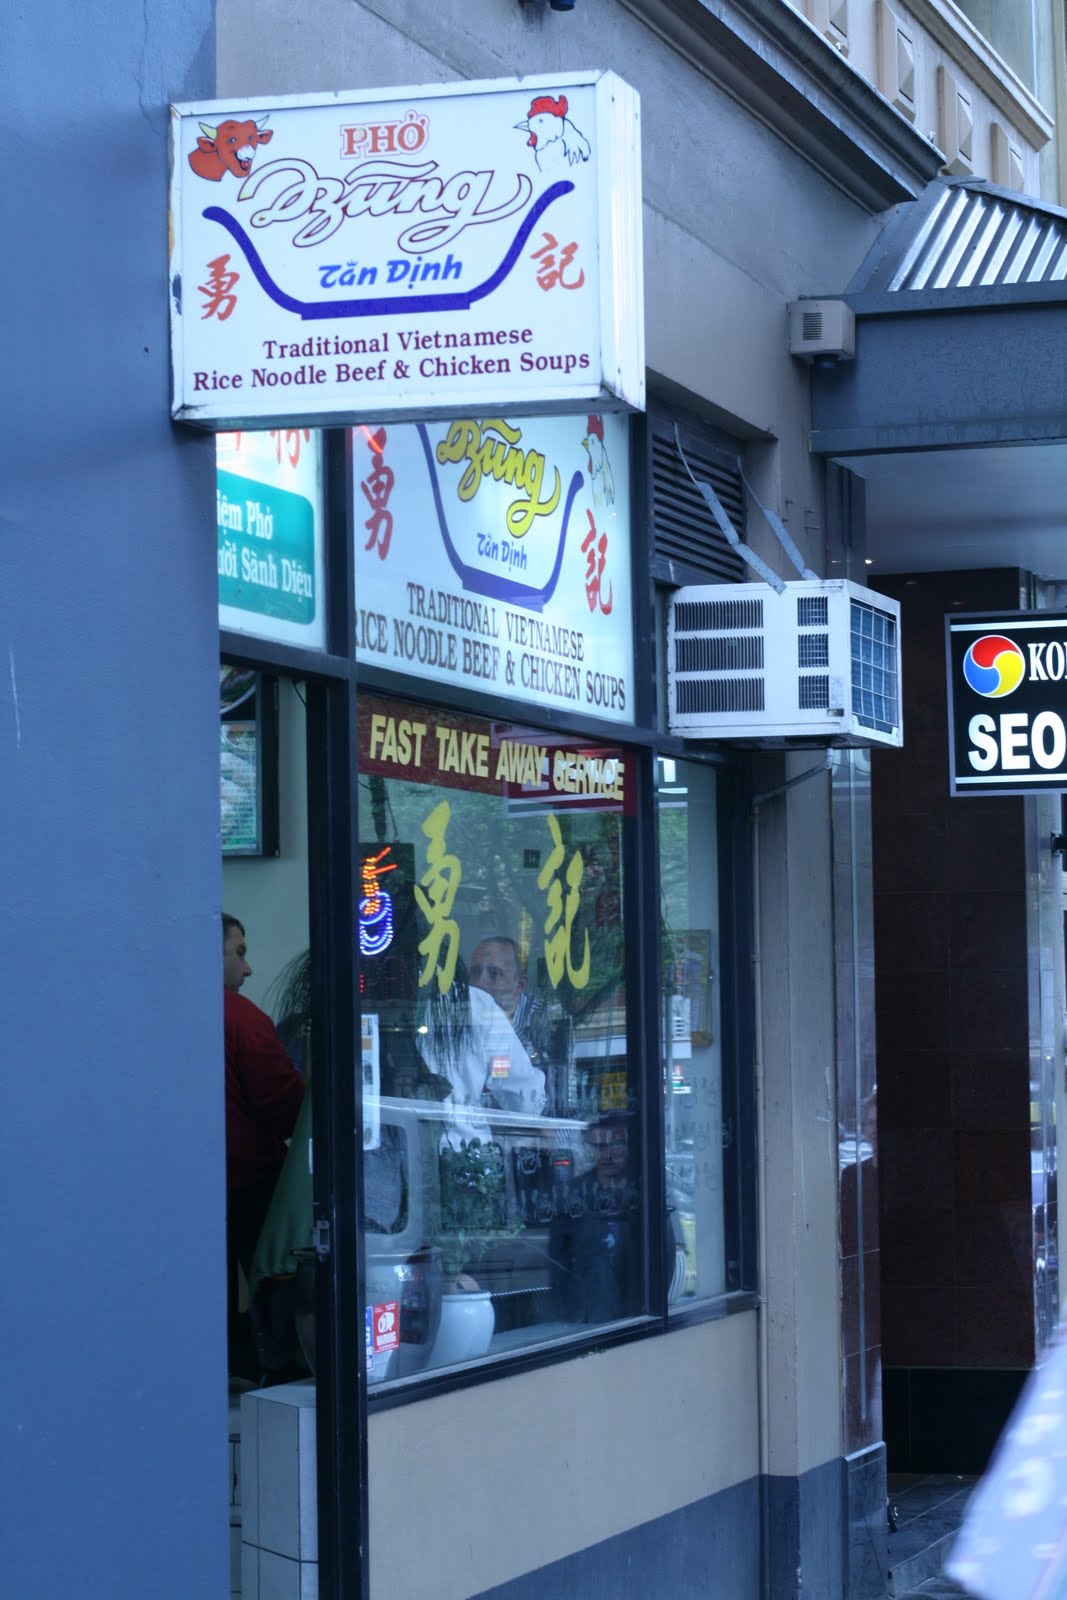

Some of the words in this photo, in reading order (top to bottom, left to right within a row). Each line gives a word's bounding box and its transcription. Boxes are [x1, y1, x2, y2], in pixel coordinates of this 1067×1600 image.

[340, 110, 429, 158] PHỞ
[198, 254, 240, 321] 勇
[530, 232, 585, 292] 記
[194, 371, 243, 391] Rice
[251, 364, 326, 387] Noodle
[335, 363, 386, 383] Beef
[393, 360, 410, 378] &
[419, 353, 511, 377] Chicken
[519, 352, 590, 375] Soups
[263, 333, 389, 360] Traditional
[398, 327, 533, 352] Vietnamese
[407, 582, 499, 639] TRADITIONAL
[505, 611, 584, 662] VIETNAMESE
[355, 609, 389, 654] ICE
[393, 618, 457, 672] NOODLE
[462, 637, 501, 682] BEEF
[505, 650, 516, 687] &
[520, 653, 581, 701] CHICKEN
[586, 670, 626, 712] SOUPS
[1027, 641, 1067, 681] KO
[369, 714, 427, 768] FAST
[436, 727, 490, 778] TAKE
[495, 740, 547, 787] AWAY
[553, 750, 625, 801] SERVICE
